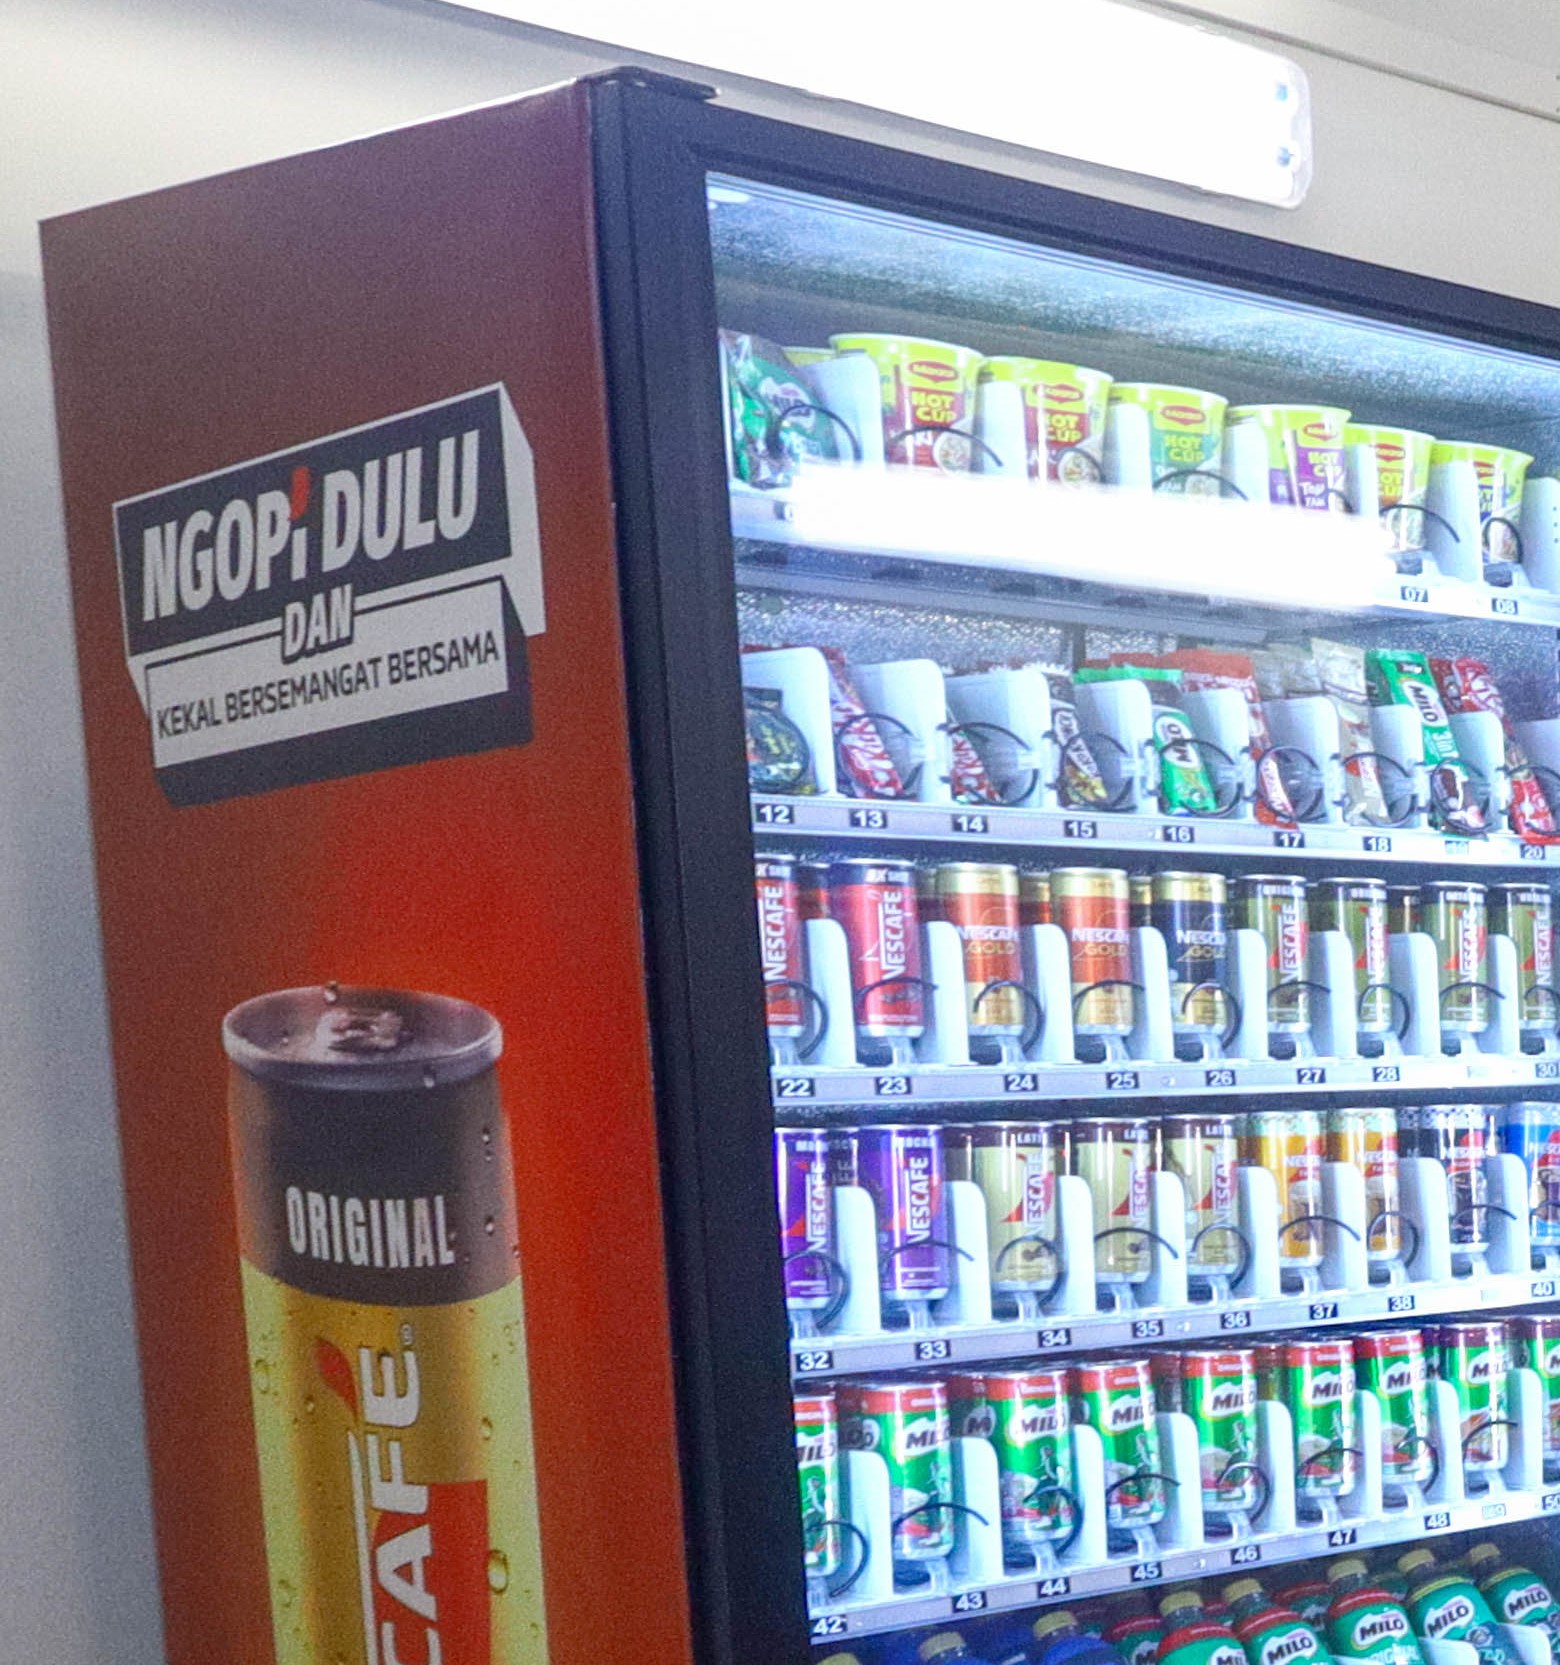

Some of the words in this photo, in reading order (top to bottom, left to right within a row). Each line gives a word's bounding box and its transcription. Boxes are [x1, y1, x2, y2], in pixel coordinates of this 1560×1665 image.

[321, 429, 480, 573] DULU
[283, 584, 353, 661] DAN
[157, 697, 223, 740] KEKAL
[225, 656, 382, 722] BERSEMANGAT
[387, 630, 499, 684] BERSAMA
[759, 806, 791, 825] 12
[854, 809, 884, 827] 13
[956, 815, 985, 833] 14
[1068, 821, 1094, 838] 15
[1166, 826, 1191, 843] 16
[1279, 832, 1303, 848] 17
[1367, 838, 1389, 852] 18
[1524, 845, 1543, 858] 20
[1206, 1070, 1233, 1087] 26
[1301, 1068, 1324, 1084] 27
[1375, 1067, 1398, 1082] 28
[1537, 1063, 1557, 1077] 30
[782, 1078, 811, 1097] 22
[879, 1077, 907, 1095] 23
[1008, 1074, 1035, 1091] 24
[1109, 1073, 1136, 1090] 25
[285, 1186, 456, 1268] ORIGINAL
[1532, 1281, 1554, 1296] 40
[1312, 1303, 1336, 1319] 37
[1391, 1296, 1413, 1310] 38
[1223, 1312, 1248, 1328] 36
[1136, 1321, 1160, 1337] 35
[1041, 1331, 1068, 1347] 34
[919, 1342, 947, 1359] 33
[799, 1353, 829, 1370] 32
[1425, 1513, 1449, 1529] 48
[1330, 1530, 1354, 1546] 47
[1233, 1546, 1258, 1562] 46
[1134, 1564, 1160, 1580] 45
[1040, 1578, 1067, 1595] 44
[955, 1593, 984, 1611] 43
[1505, 1589, 1551, 1621] MILO
[813, 1617, 843, 1634] 42
[1359, 1617, 1405, 1641] MILO
[1425, 1604, 1470, 1639] MILO
